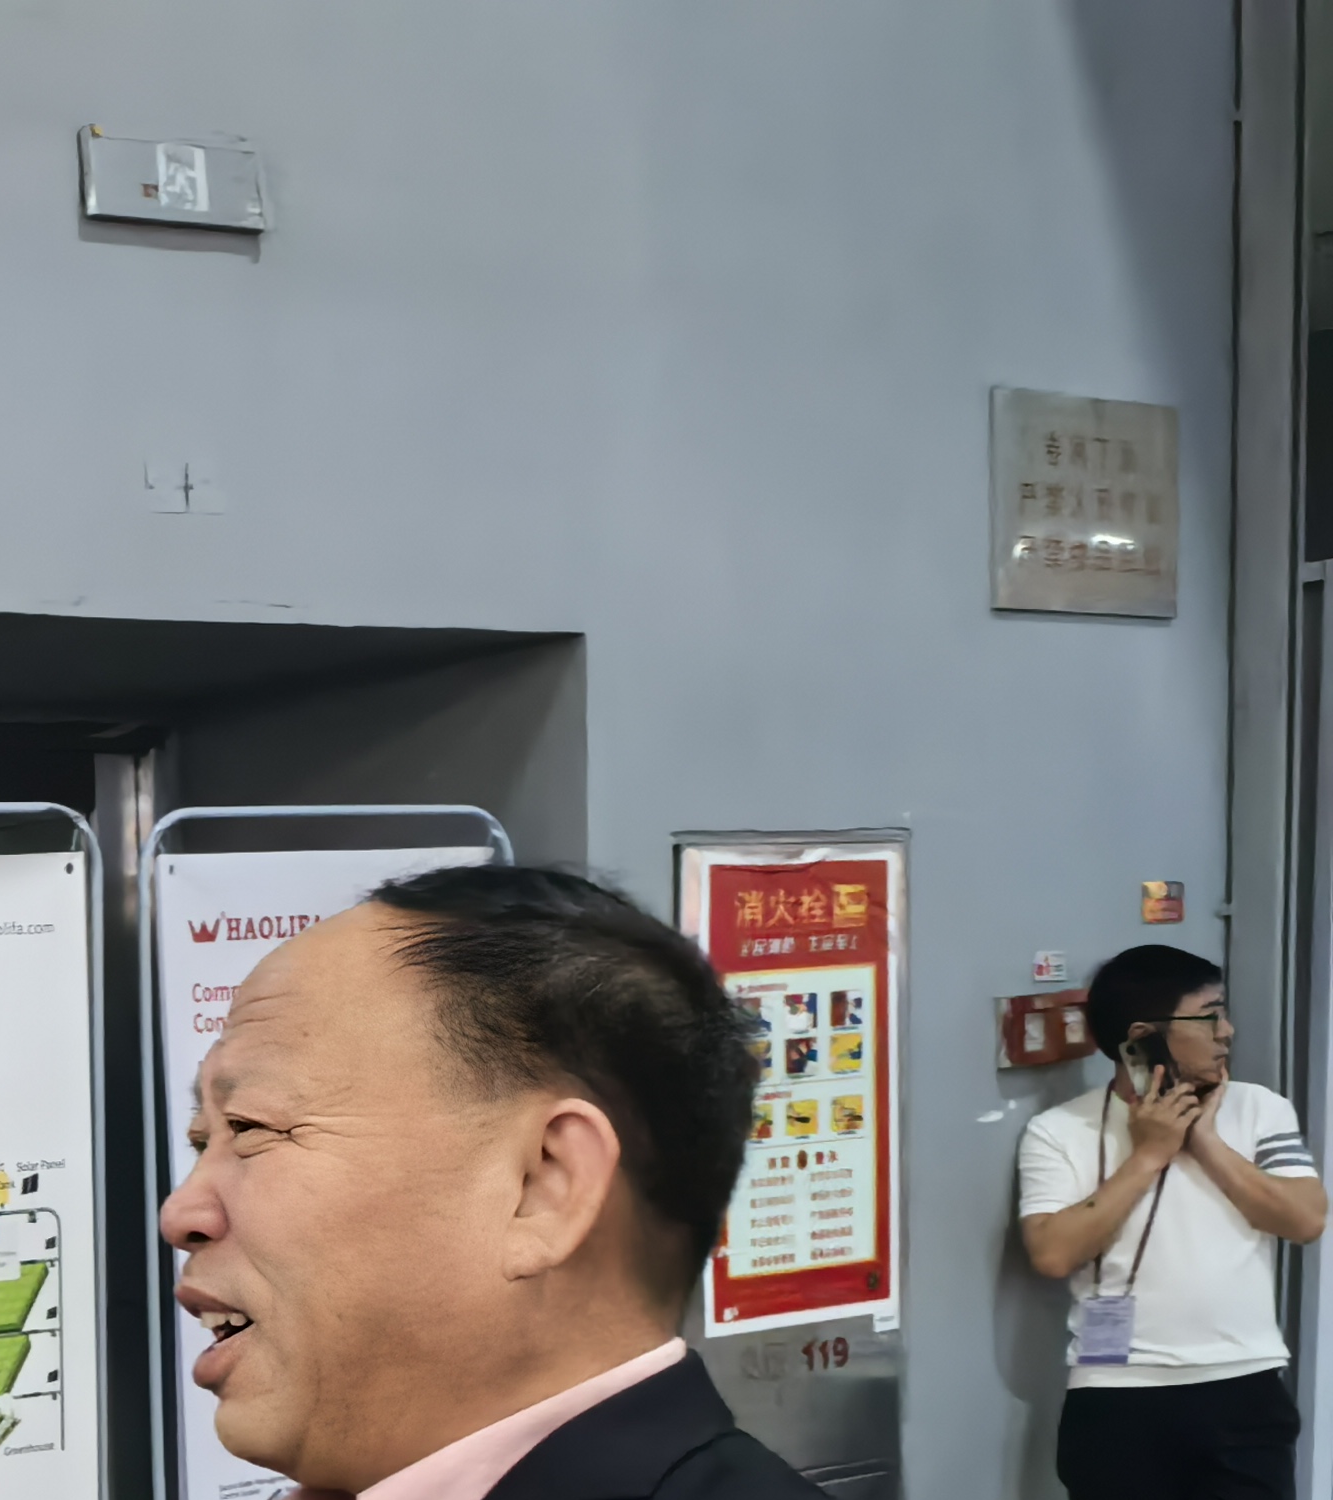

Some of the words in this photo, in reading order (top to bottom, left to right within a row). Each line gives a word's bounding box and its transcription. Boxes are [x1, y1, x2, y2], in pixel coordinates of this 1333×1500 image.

[735, 887, 828, 928] 消火栓
[226, 914, 321, 941] HAOLIF
[801, 1336, 850, 1372] 119
